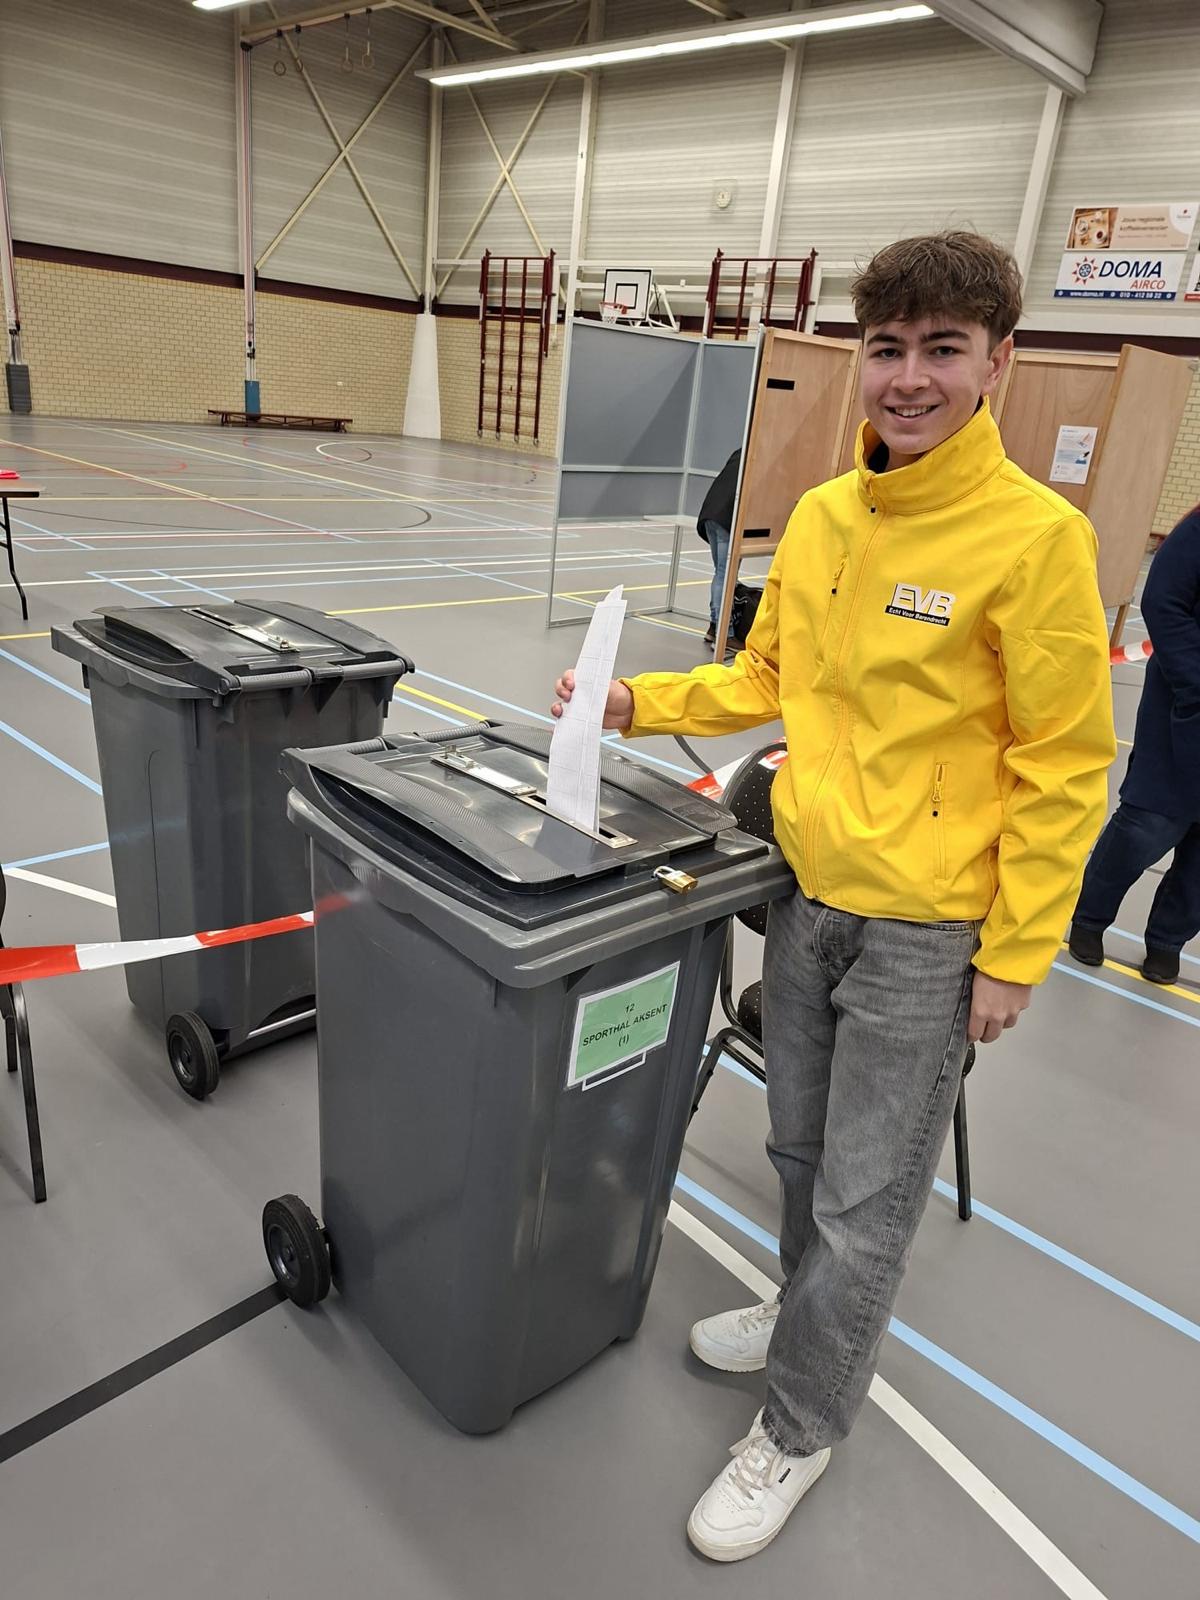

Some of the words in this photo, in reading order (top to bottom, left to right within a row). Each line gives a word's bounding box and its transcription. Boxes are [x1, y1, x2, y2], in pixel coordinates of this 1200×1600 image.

[1098, 260, 1162, 278] DOMA
[1130, 279, 1166, 290] AIRCO
[890, 583, 956, 617] EVB
[888, 607, 901, 615] Echt
[902, 610, 914, 618] Voor
[915, 613, 947, 625] Barendrecht
[625, 1003, 636, 1013] 12
[582, 1020, 632, 1046] SPORTHAL
[633, 1003, 668, 1024] AKSENT
[618, 1034, 630, 1047] (1)
